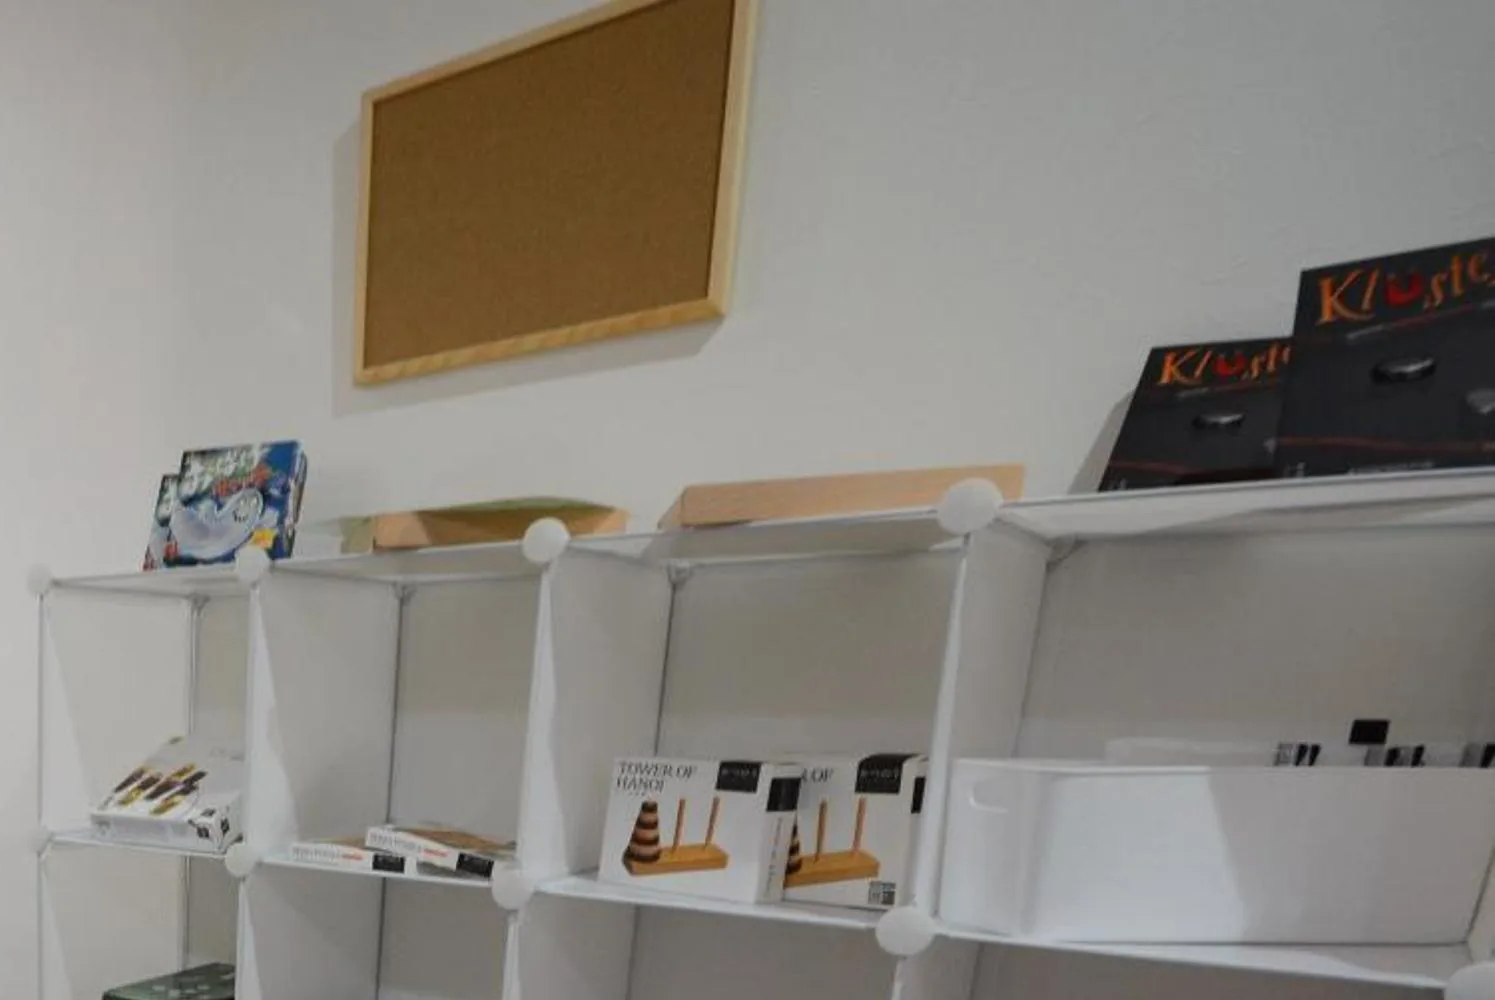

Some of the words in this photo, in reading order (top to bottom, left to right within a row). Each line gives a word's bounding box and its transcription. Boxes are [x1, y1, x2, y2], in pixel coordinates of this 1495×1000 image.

[1316, 253, 1495, 325] Kluste
[619, 760, 673, 778] TOWER
[676, 764, 698, 779] OF
[616, 775, 665, 793] HANOI
